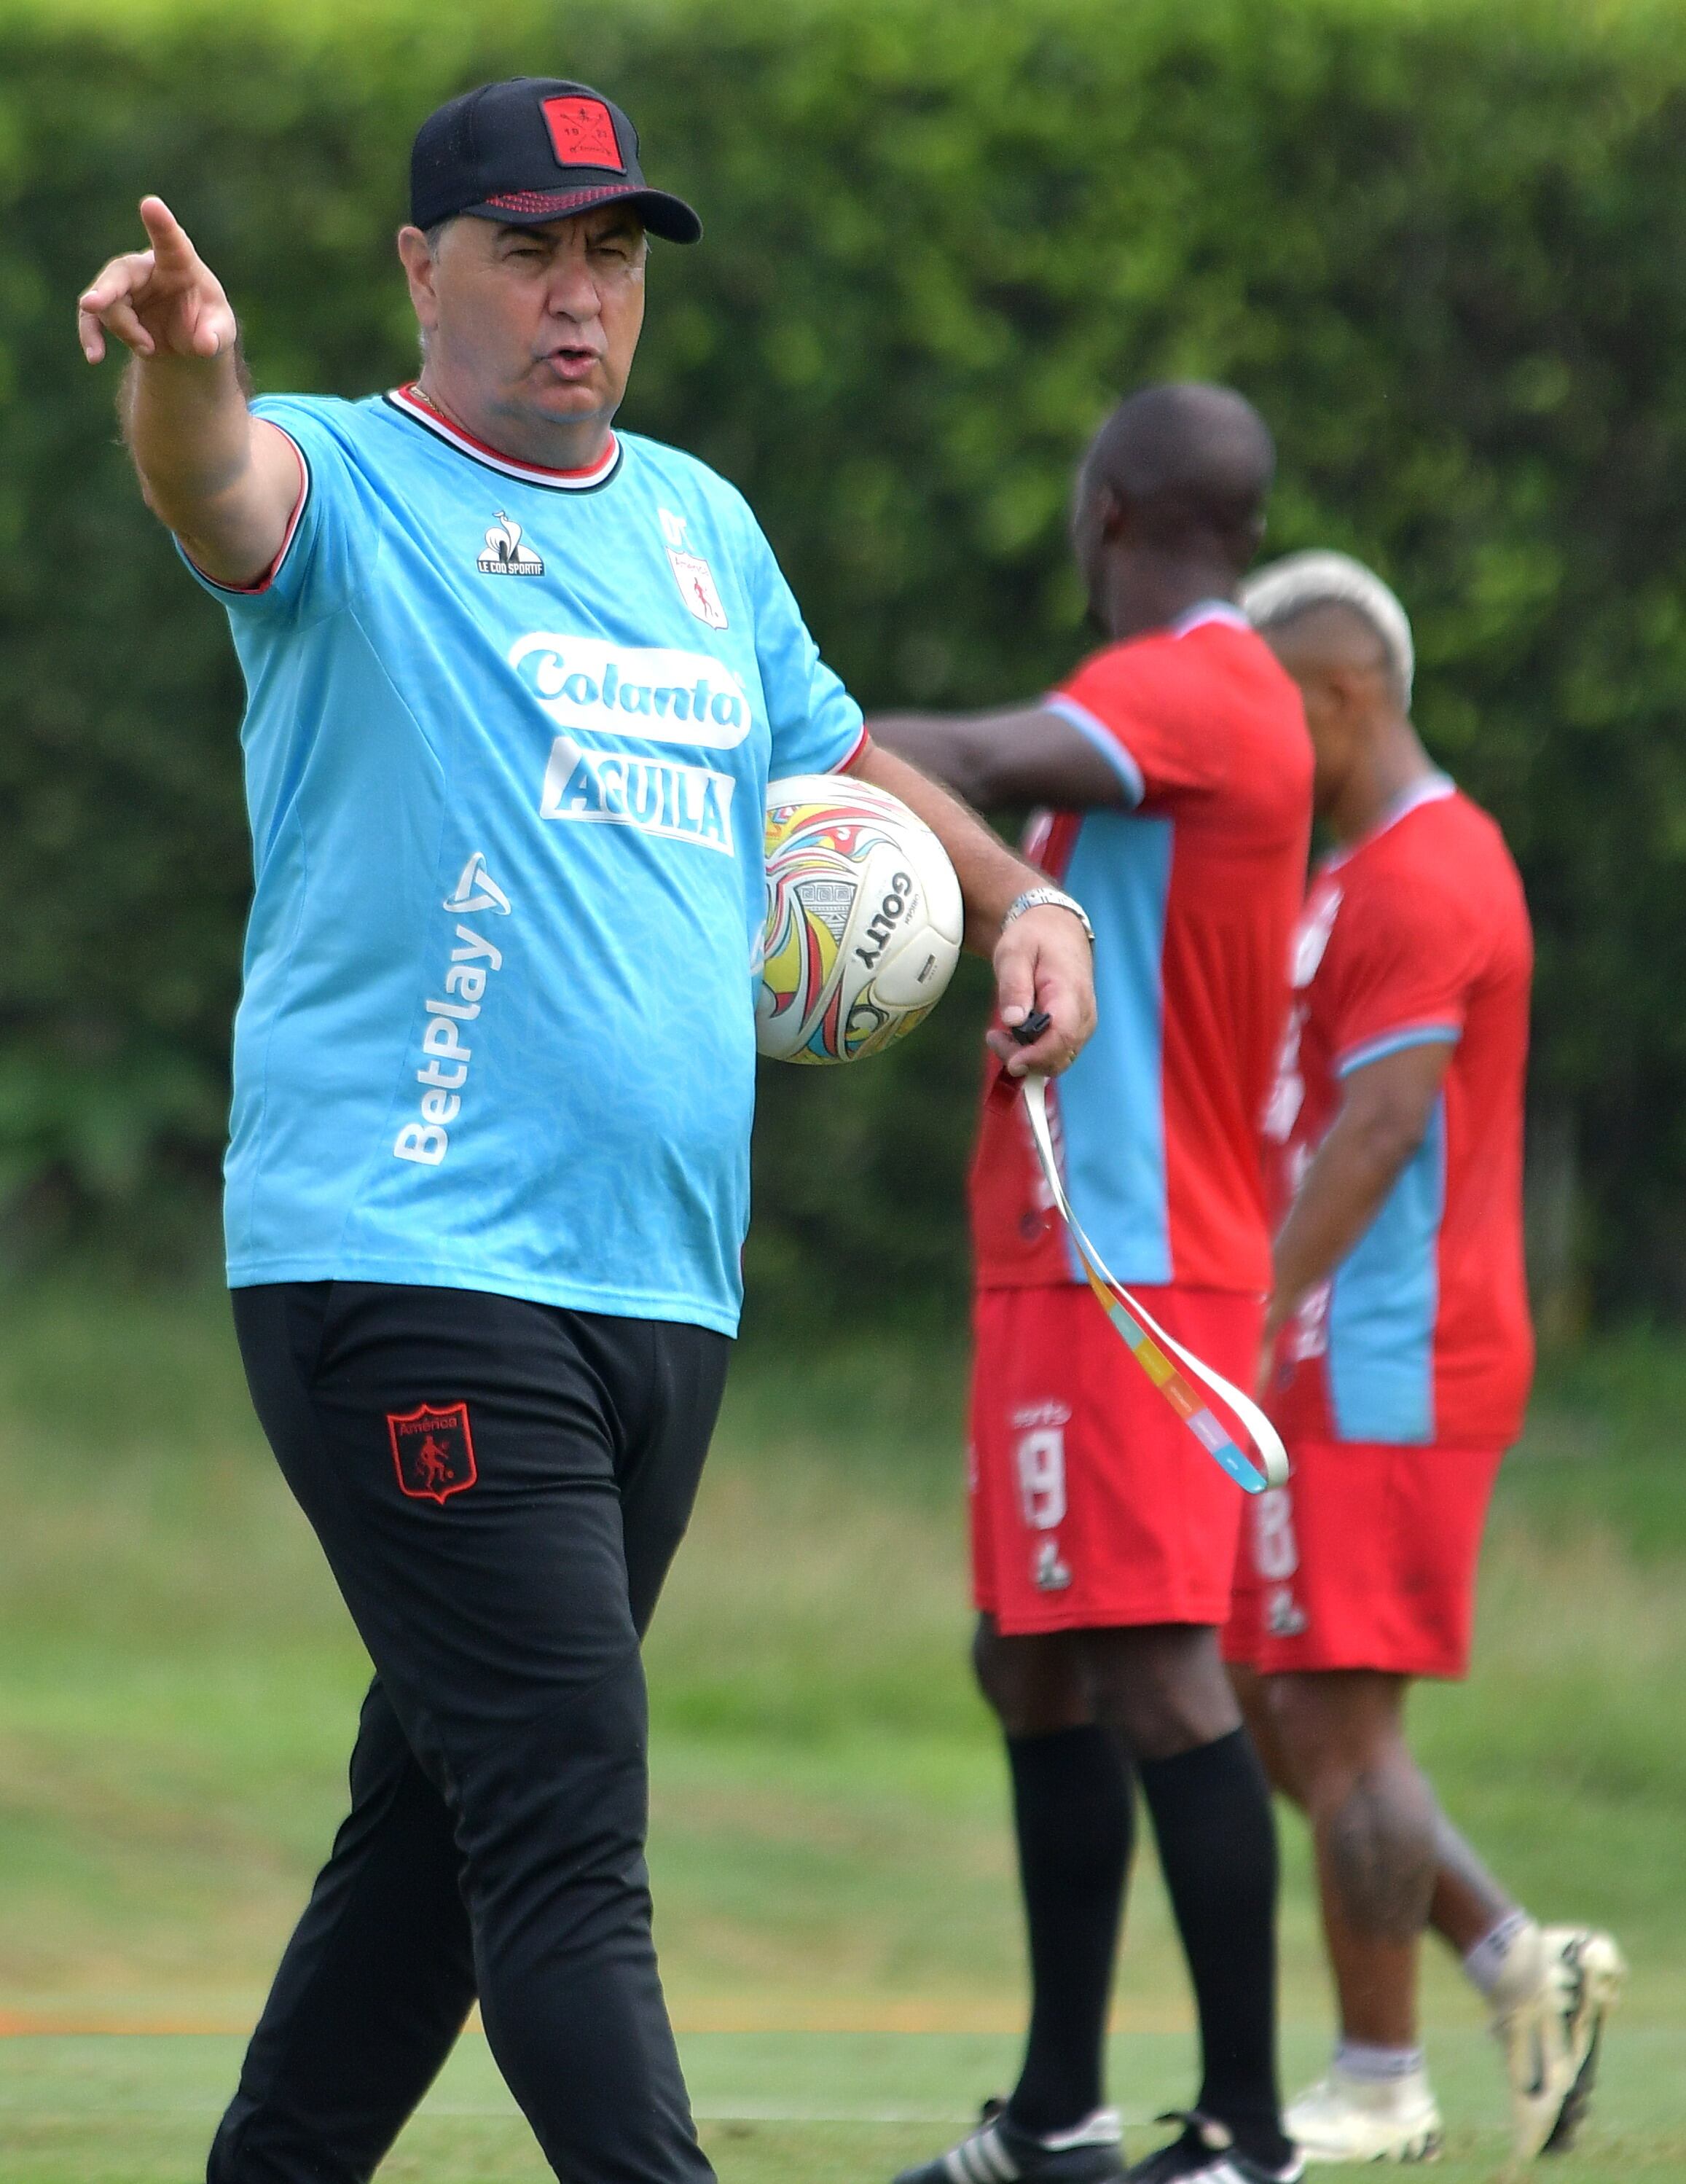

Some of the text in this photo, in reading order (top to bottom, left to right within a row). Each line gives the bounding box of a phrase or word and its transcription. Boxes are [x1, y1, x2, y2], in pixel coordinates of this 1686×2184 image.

[478, 561, 543, 575] LE COQ SPORTIF
[516, 649, 743, 728] Colanta
[855, 872, 913, 970] GOLTY
[393, 923, 503, 1166] BetPlay
[1019, 1428, 1067, 1530] 9
